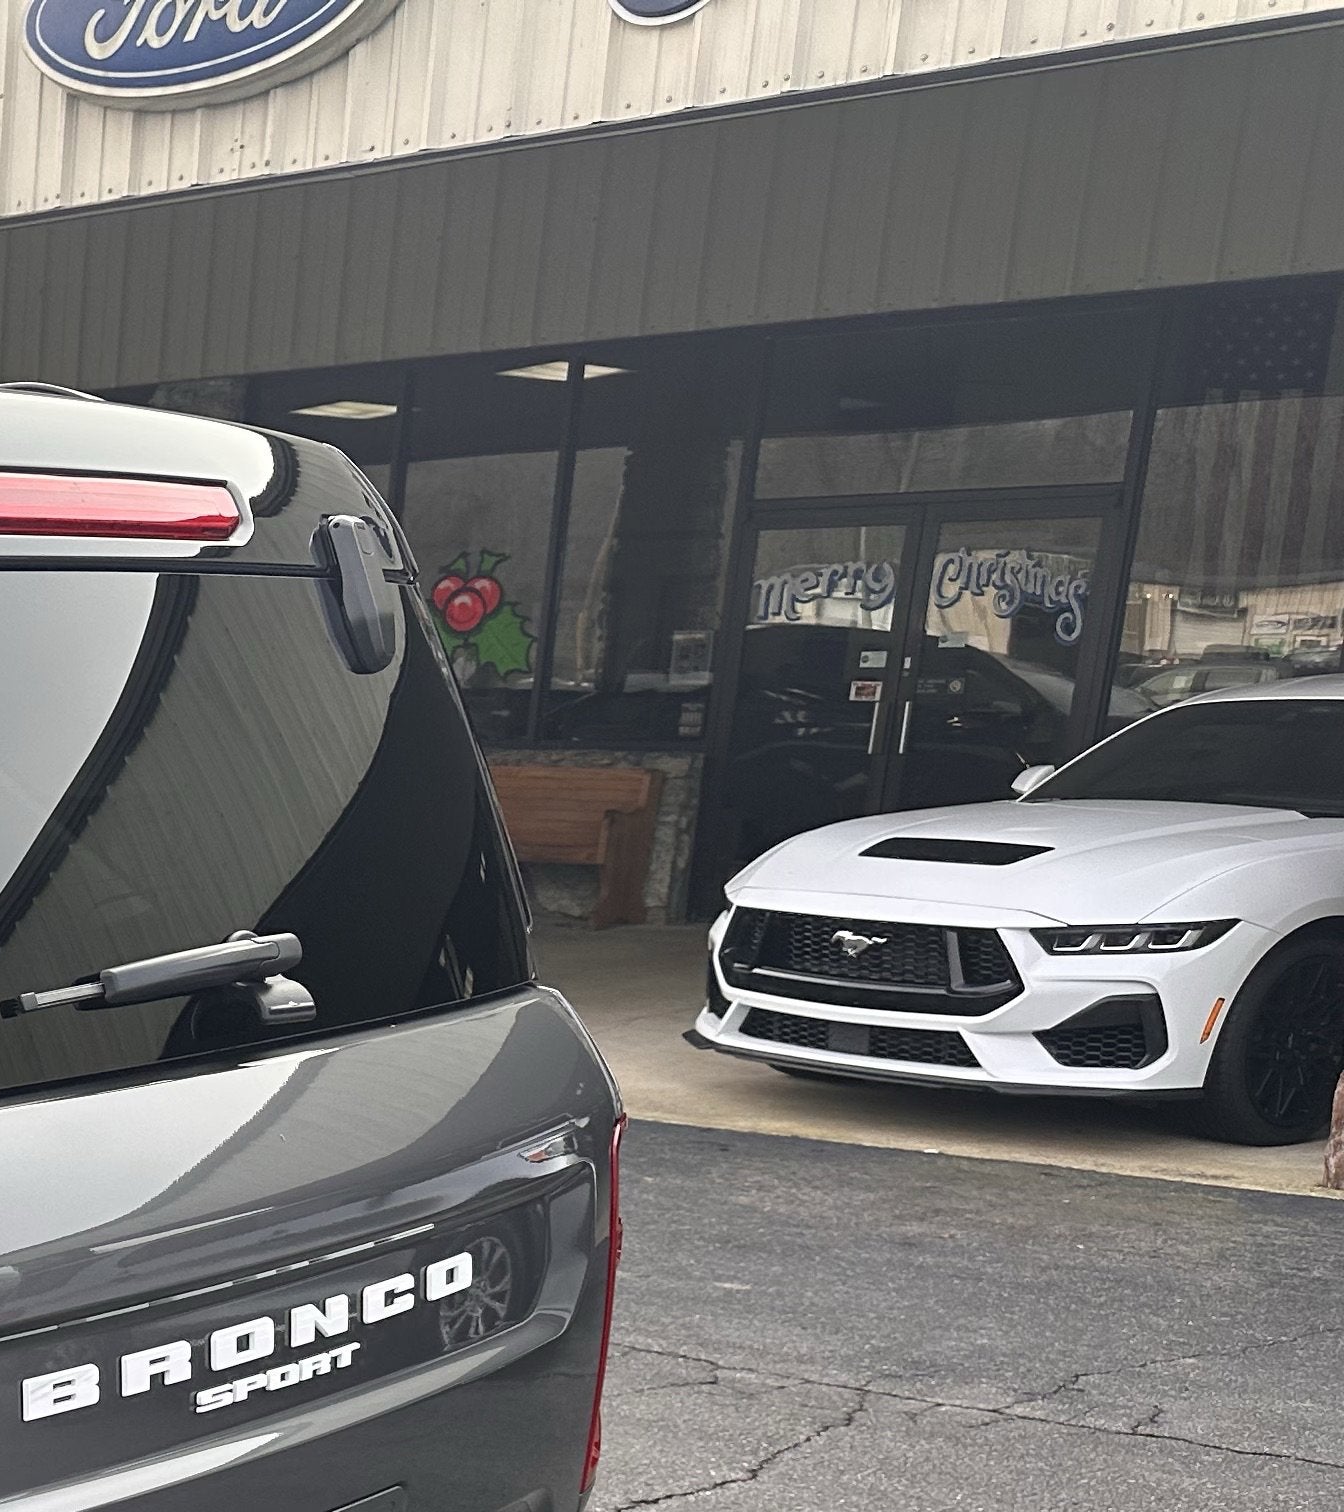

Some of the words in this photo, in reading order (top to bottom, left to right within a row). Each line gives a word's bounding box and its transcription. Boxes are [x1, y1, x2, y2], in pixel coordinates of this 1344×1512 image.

[930, 547, 1089, 641] Christmas
[21, 1251, 473, 1422] BRONCO
[195, 1342, 361, 1414] SPORT
